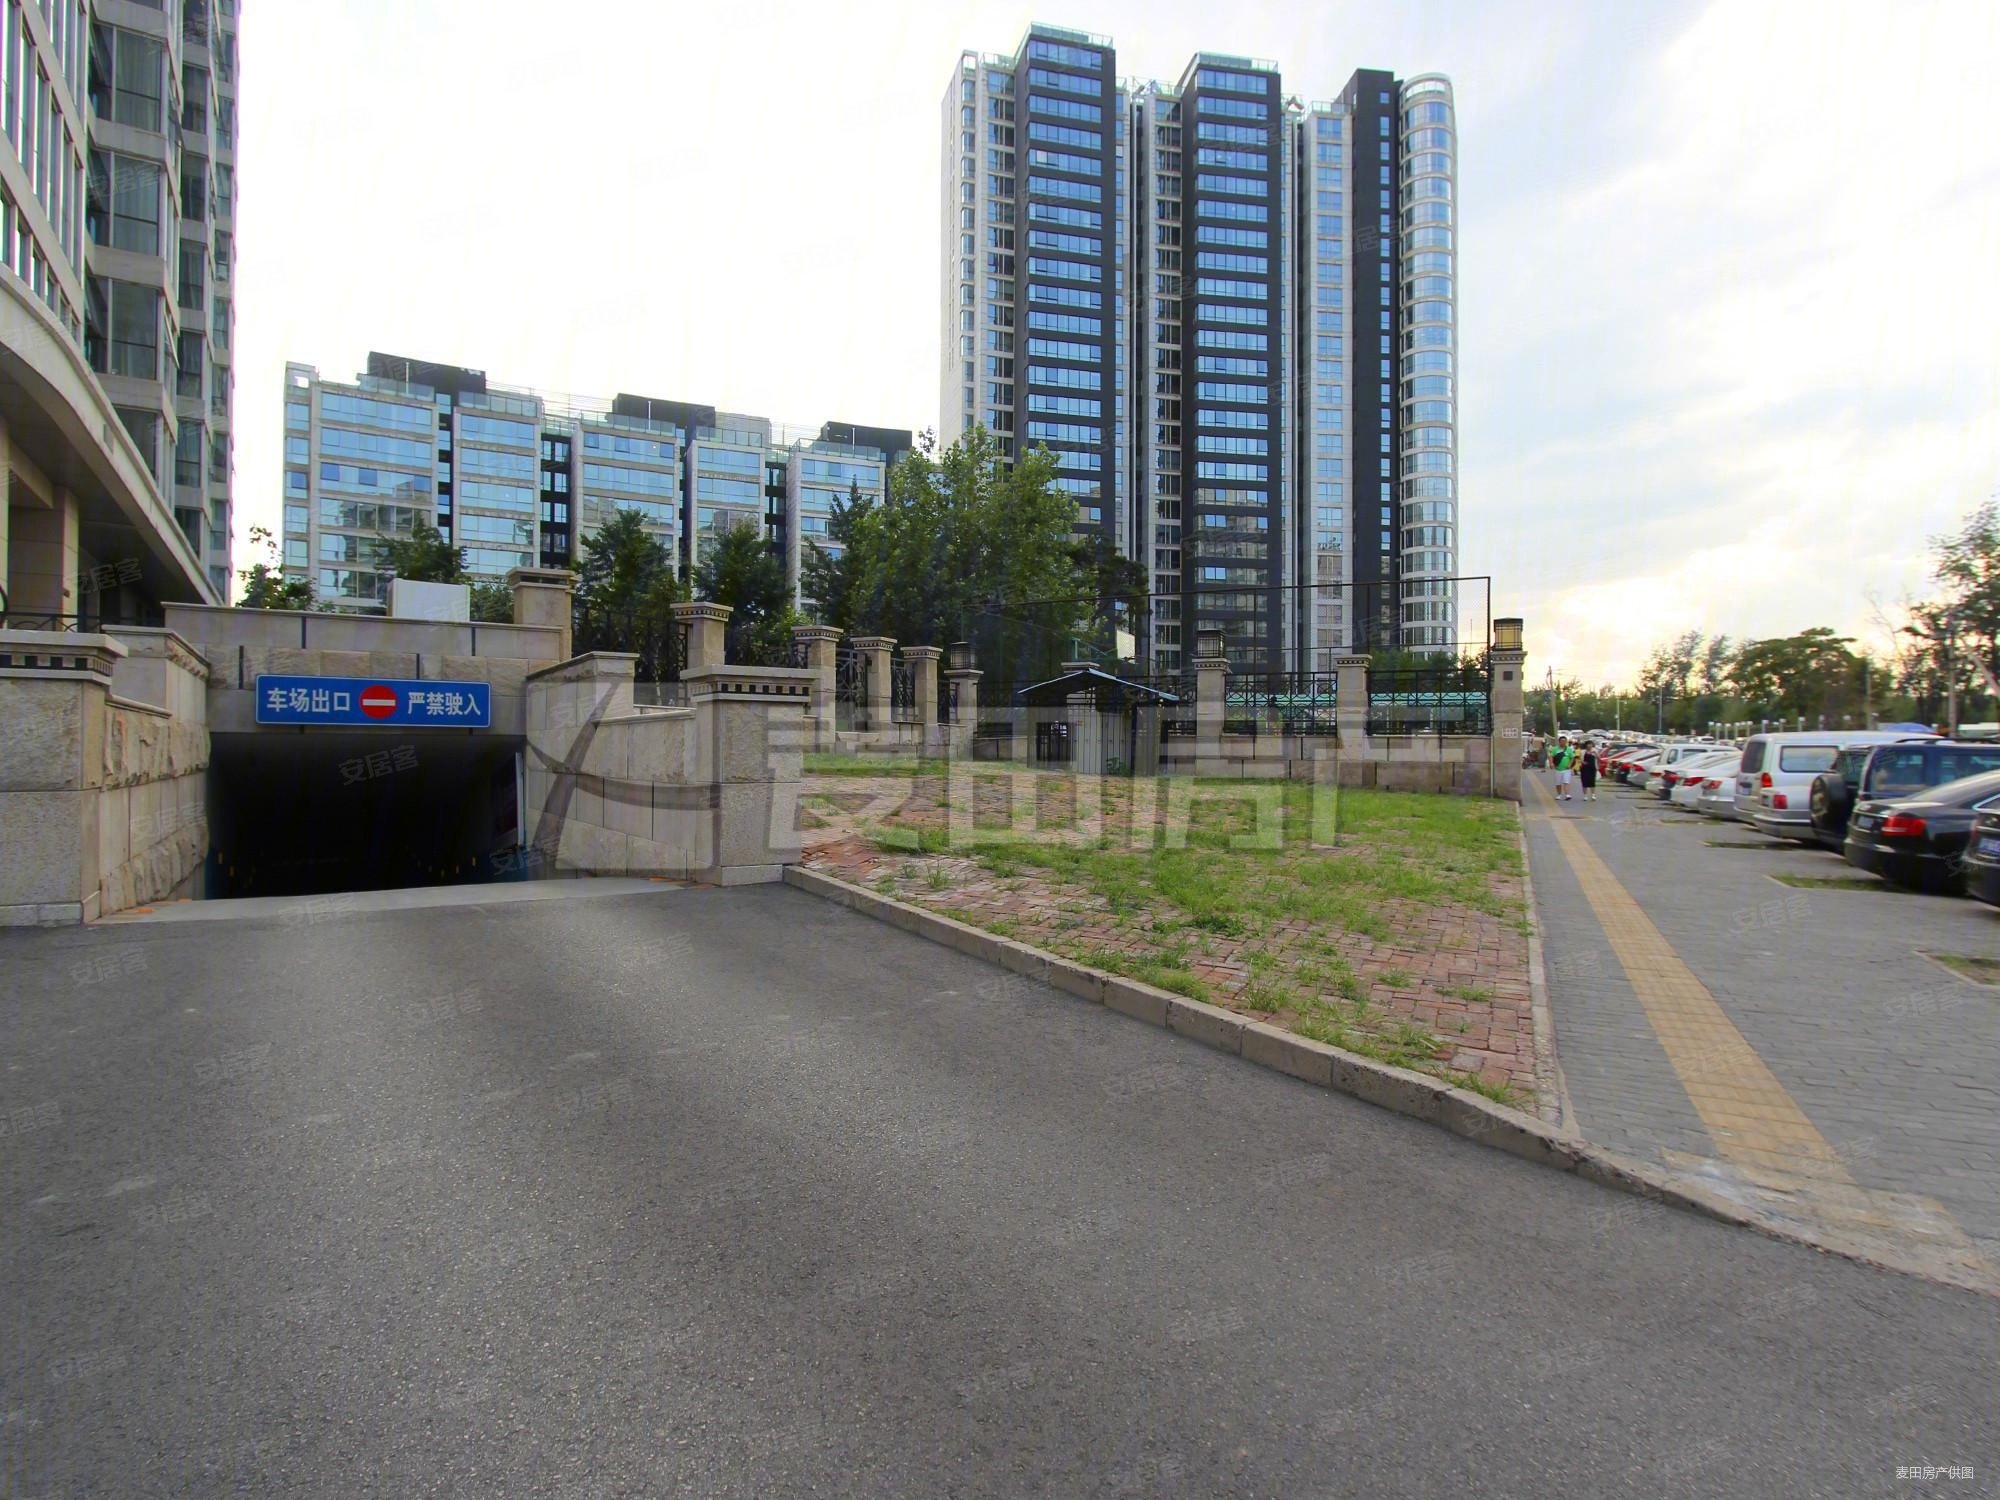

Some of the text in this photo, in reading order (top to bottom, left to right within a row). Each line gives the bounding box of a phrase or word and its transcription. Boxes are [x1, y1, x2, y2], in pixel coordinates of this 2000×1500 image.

[266, 687, 481, 717] 车场出口 严禁驶入
